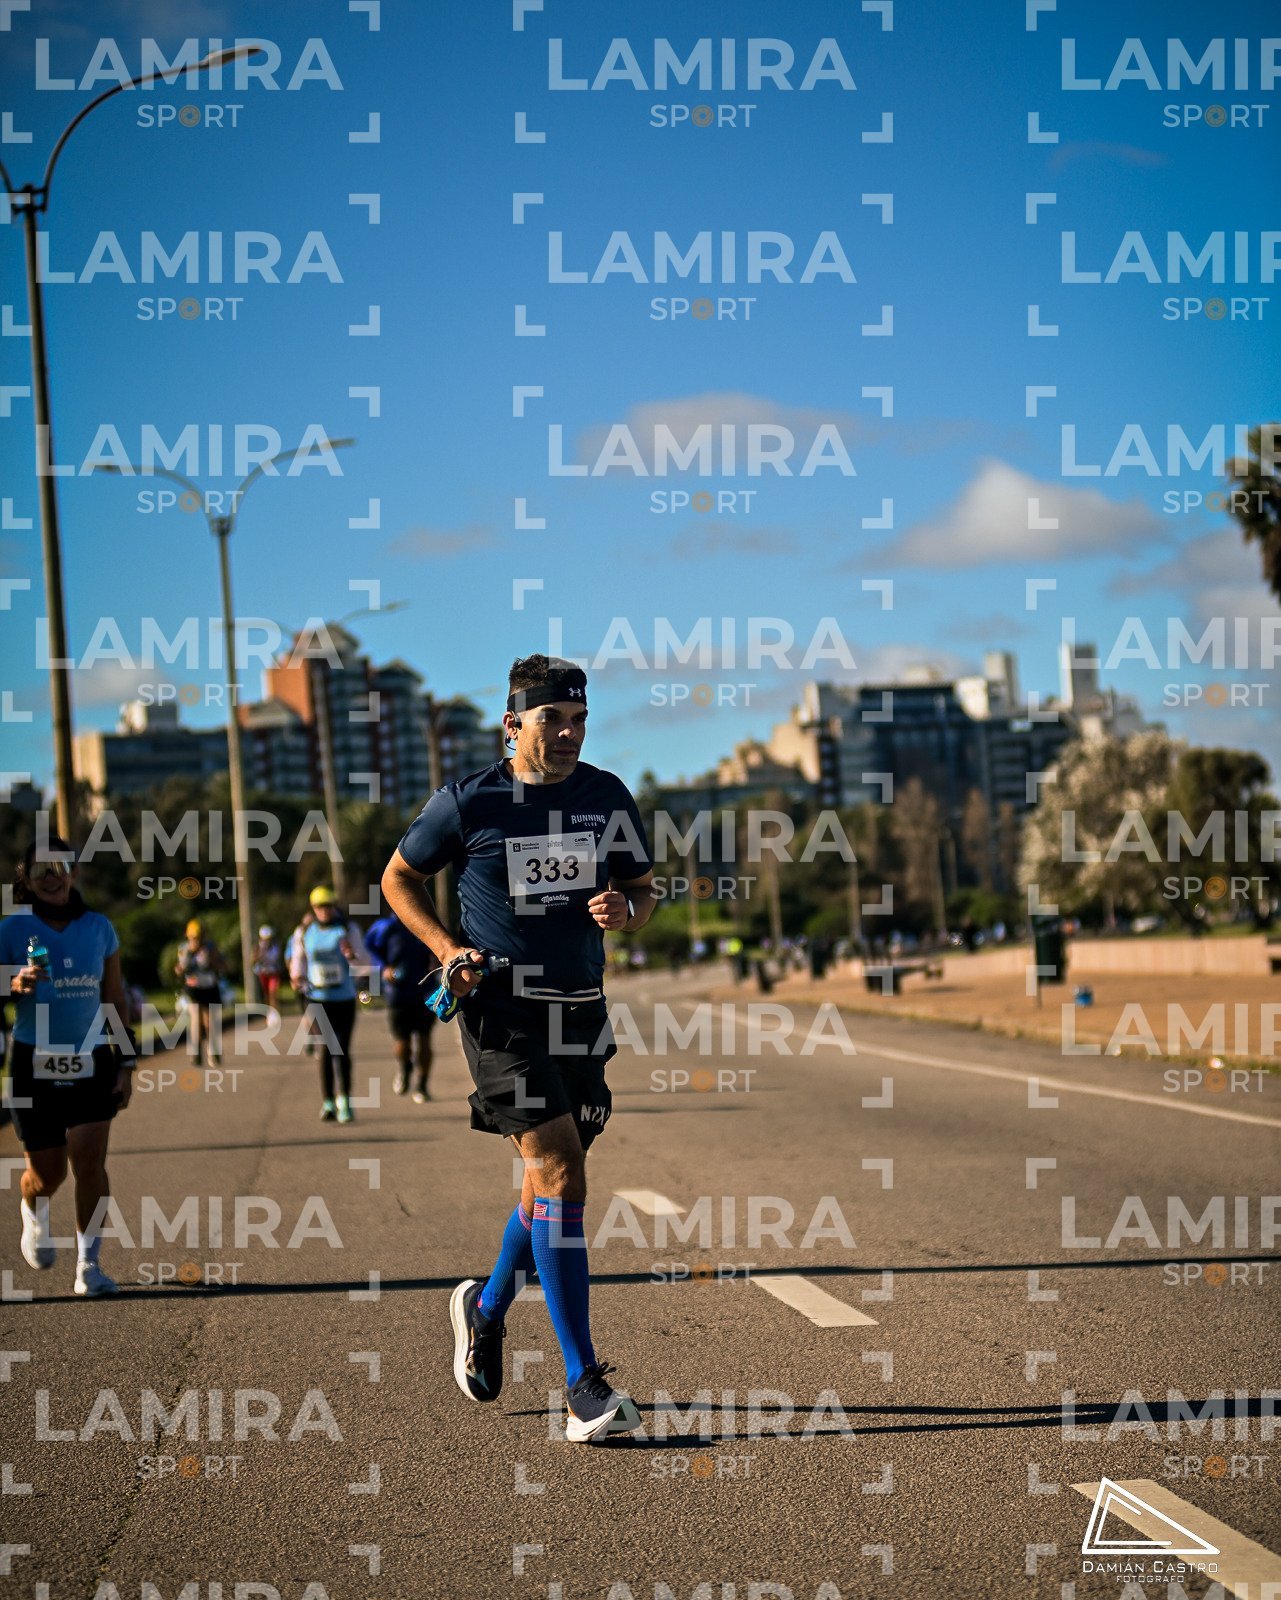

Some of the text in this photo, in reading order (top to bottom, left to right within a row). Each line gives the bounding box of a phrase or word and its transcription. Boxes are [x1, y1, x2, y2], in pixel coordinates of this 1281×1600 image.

[571, 814, 606, 824] RUNNING
[525, 855, 580, 885] 333
[53, 974, 99, 988] aratón
[44, 1056, 83, 1074] 455
